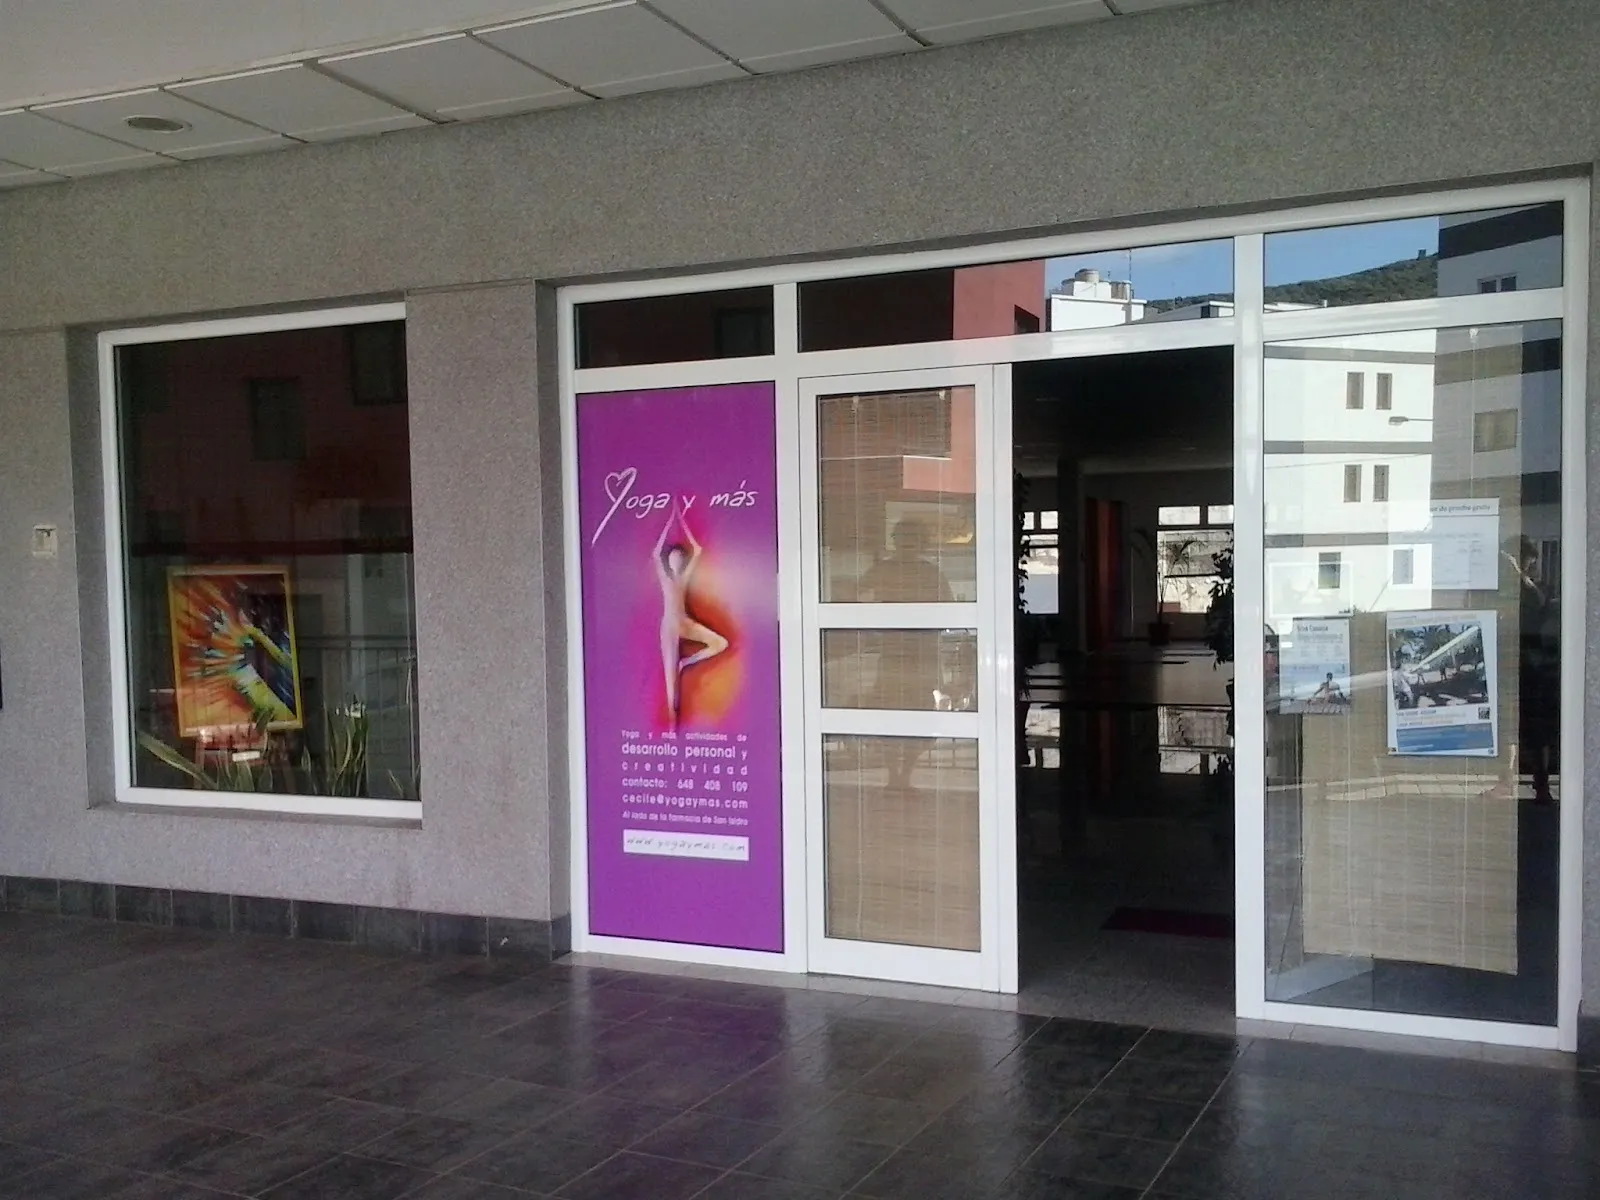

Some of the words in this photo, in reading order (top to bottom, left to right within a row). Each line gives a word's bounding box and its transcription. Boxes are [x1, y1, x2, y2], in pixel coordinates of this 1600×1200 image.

[591, 466, 671, 548] Yoga
[682, 494, 696, 517] y
[709, 479, 758, 507] más
[621, 742, 678, 756] desarrollo
[685, 746, 736, 758] personal
[741, 749, 748, 761] y
[622, 777, 668, 788] contacto:
[732, 781, 748, 792] 109
